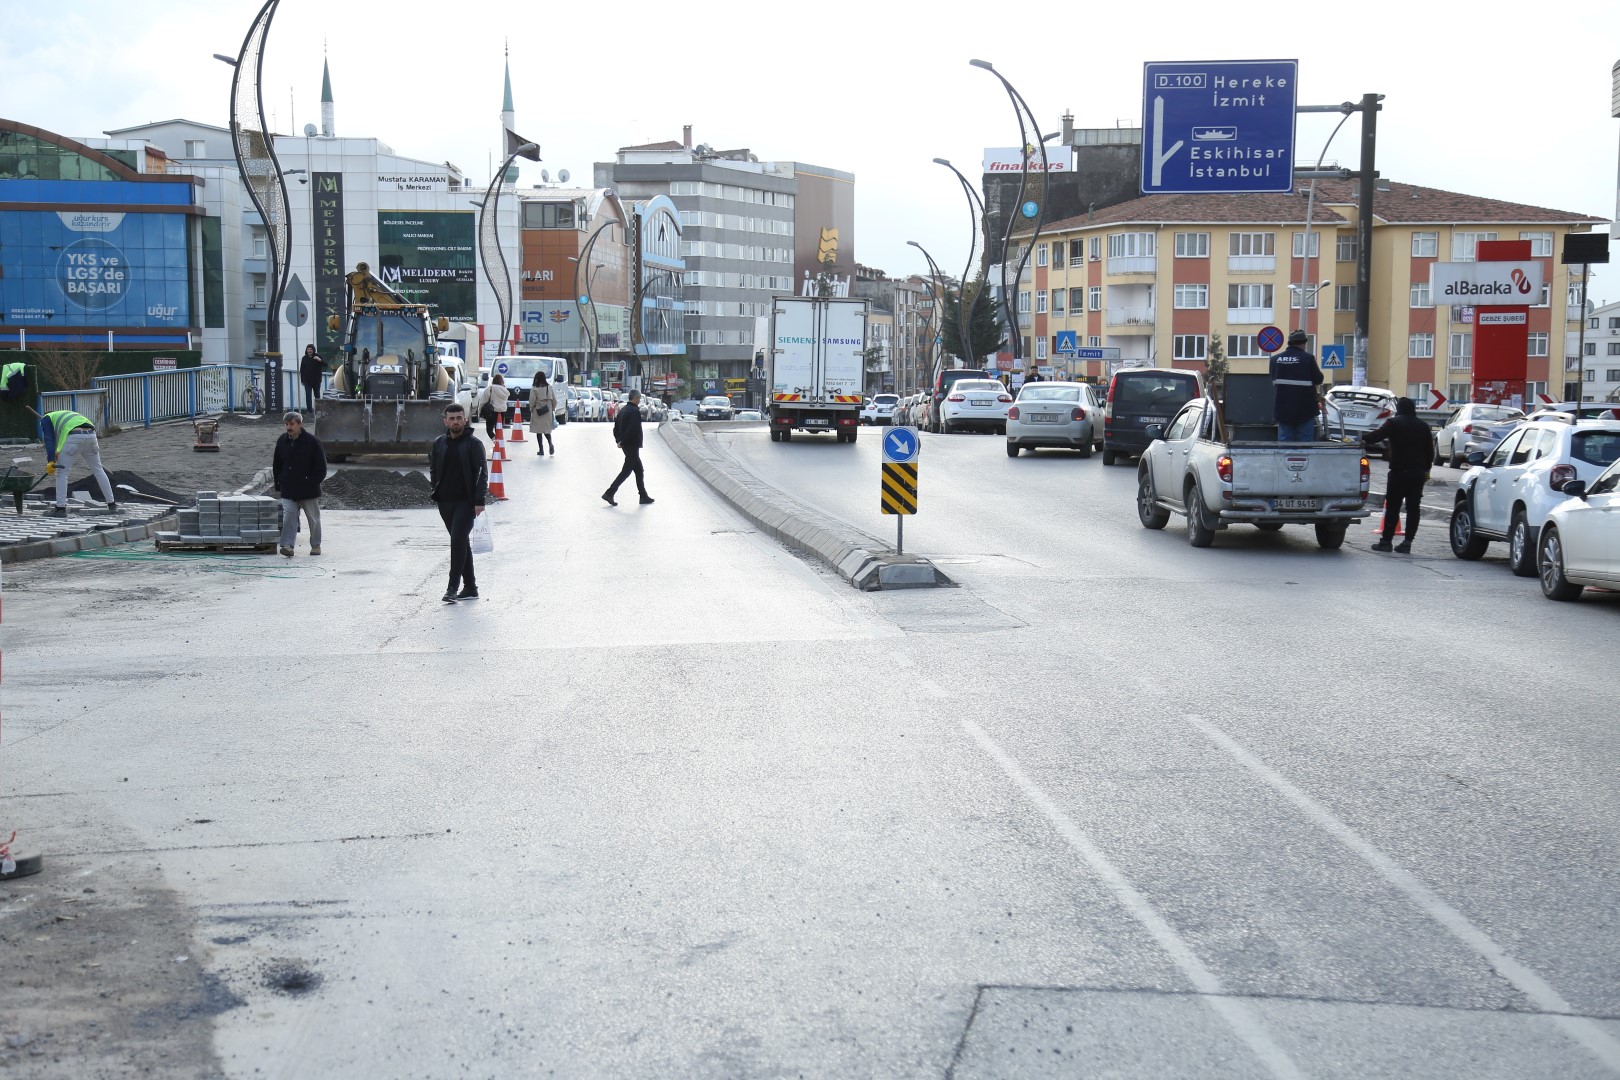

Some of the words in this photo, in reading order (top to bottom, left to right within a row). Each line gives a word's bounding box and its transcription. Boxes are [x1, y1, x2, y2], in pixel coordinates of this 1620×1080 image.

[1159, 76, 1202, 87] D.100
[1214, 75, 1287, 89] Hereke
[1213, 91, 1265, 107] İzmit
[1190, 147, 1285, 160] Eskihisar
[1190, 162, 1270, 178] İstanbul
[92, 214, 109, 222] kurs
[319, 199, 340, 276] MELİDERM
[67, 253, 97, 265] YKS
[100, 257, 119, 266] ve
[401, 267, 456, 277] MELİDERM
[67, 281, 121, 297] BAŞARI
[1444, 281, 1512, 295] alBaraka
[147, 303, 178, 318] uğur
[1503, 314, 1525, 322] ŞUBESİ
[778, 336, 817, 345] SIEMENS
[822, 337, 861, 345] SAMSUNG
[369, 364, 403, 374] CAT
[1297, 500, 1316, 508] 9415
